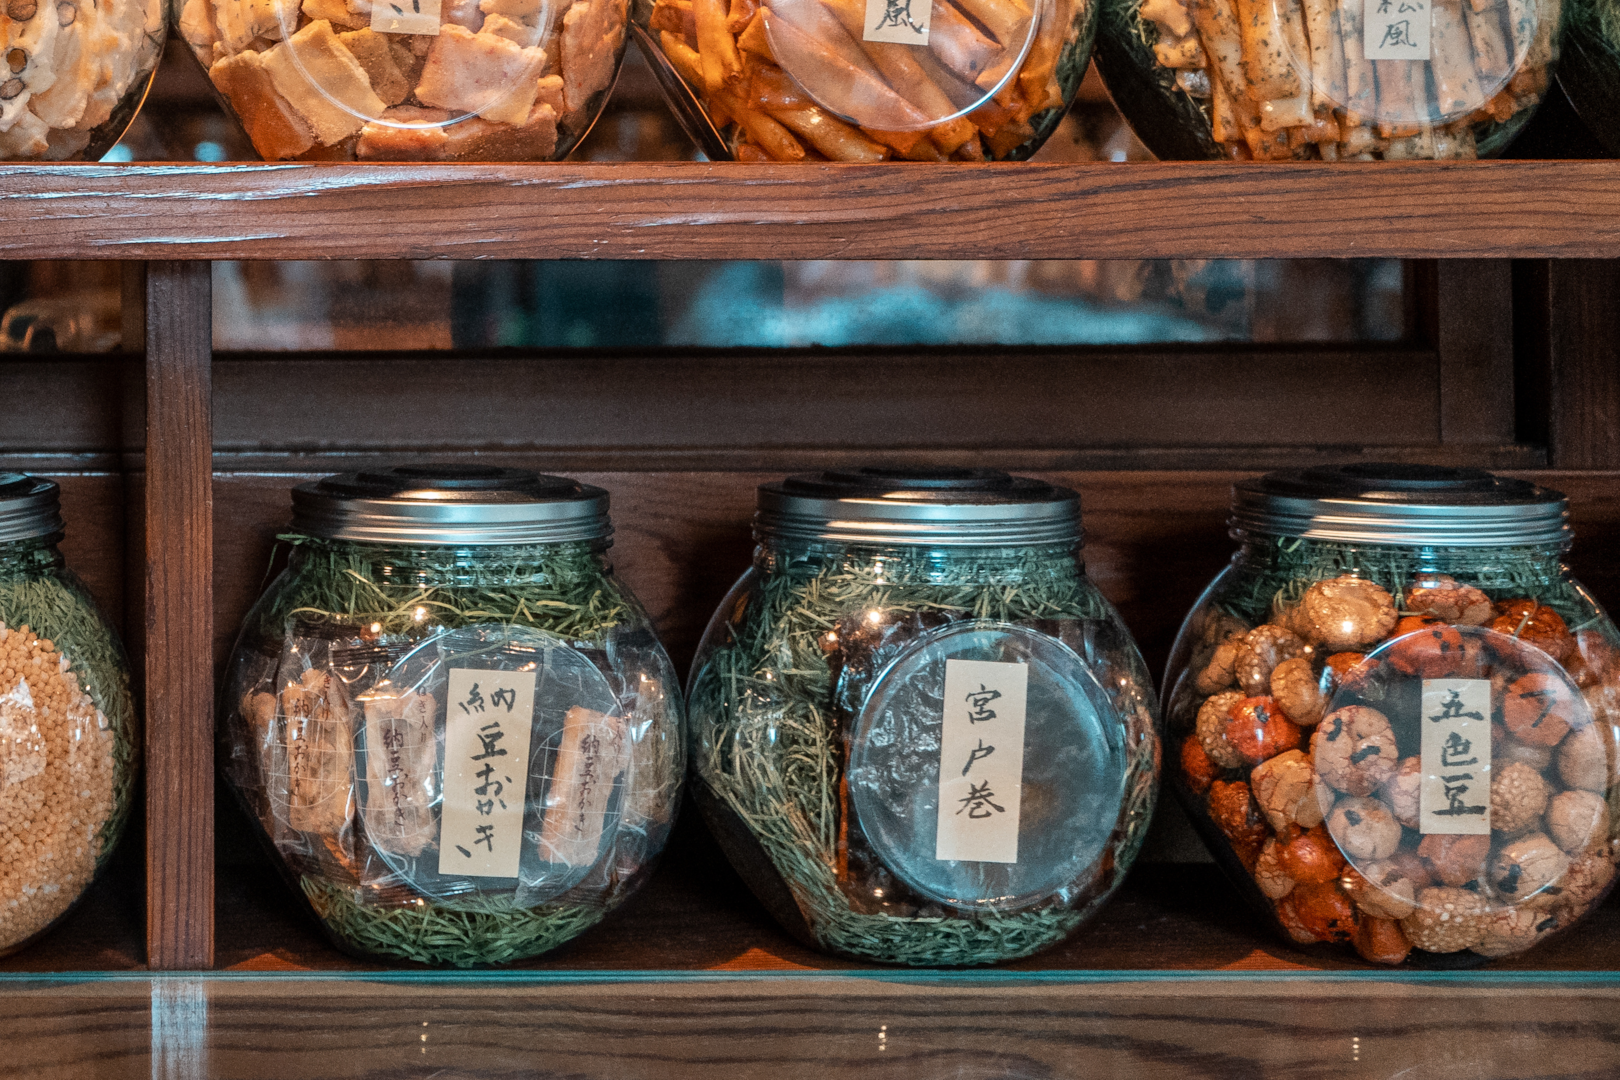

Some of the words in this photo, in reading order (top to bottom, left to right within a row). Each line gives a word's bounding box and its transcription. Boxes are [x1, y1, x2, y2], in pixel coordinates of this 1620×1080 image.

[456, 682, 517, 858] 納豆おかき
[1428, 688, 1487, 817] 五色豆
